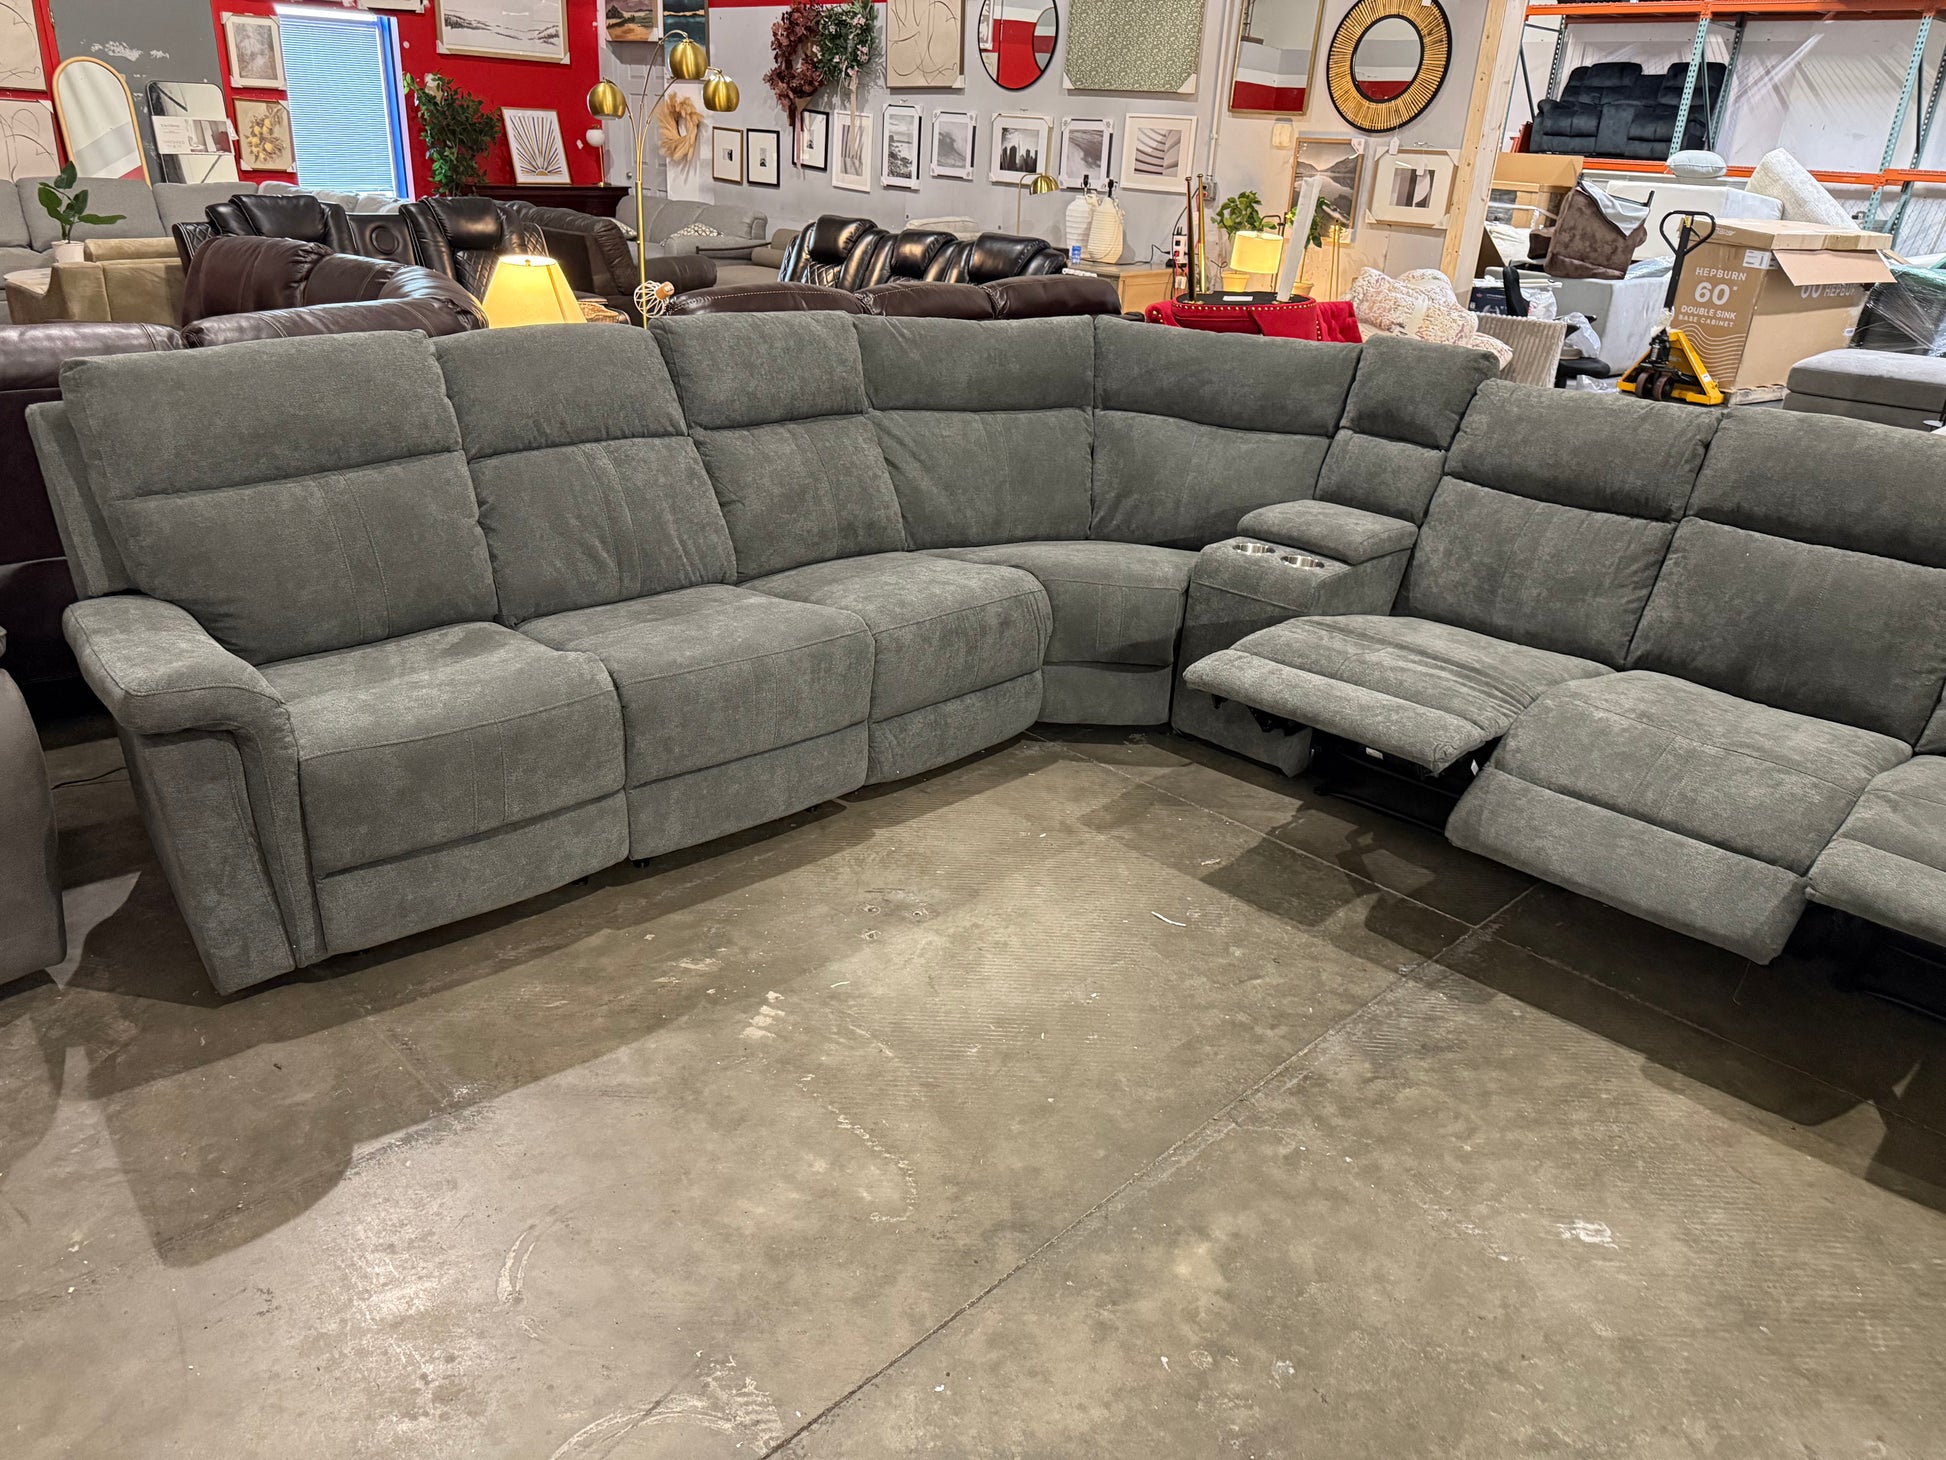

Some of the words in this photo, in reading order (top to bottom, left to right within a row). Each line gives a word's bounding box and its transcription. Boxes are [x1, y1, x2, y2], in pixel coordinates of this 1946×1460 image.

[1695, 267, 1747, 281] HEPBURN
[1681, 305, 1716, 317] DOUBLE
[1716, 310, 1737, 320] SINK
[1678, 314, 1698, 323] BASE
[1700, 317, 1734, 328] CABINET
